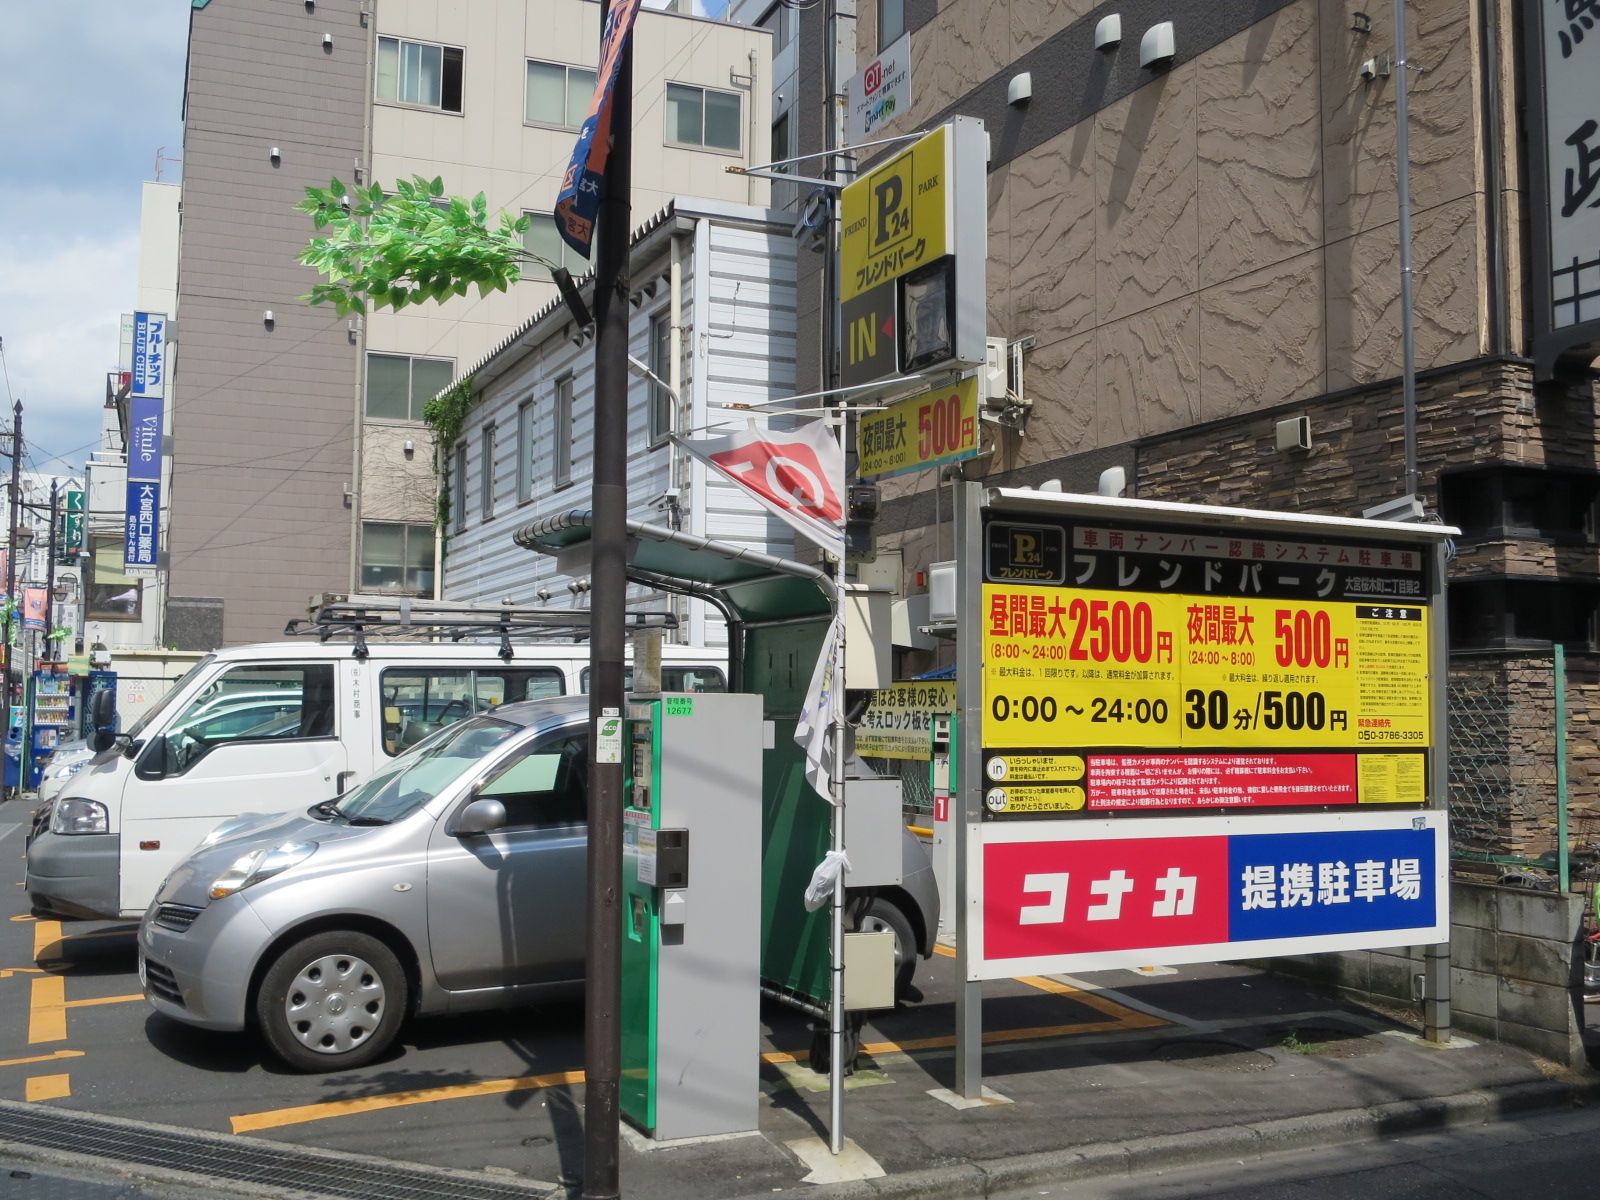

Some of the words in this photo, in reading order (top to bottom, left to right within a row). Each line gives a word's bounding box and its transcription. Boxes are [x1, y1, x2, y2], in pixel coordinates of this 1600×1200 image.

[918, 175, 938, 196] PARK
[856, 238, 926, 290] フレンドパーク
[137, 322, 147, 353] BLUE
[147, 320, 163, 385] ブルーチップ
[850, 312, 876, 365] IN
[135, 355, 146, 385] CHIP
[141, 416, 158, 462] Vitule
[863, 413, 907, 458] 夜間最大
[918, 394, 974, 460] 500円
[70, 493, 83, 545] くすり
[128, 515, 137, 562] 処方せん受付
[138, 484, 154, 562] 大宮西口薬局
[1083, 529, 1413, 568] 車両ナンバー認識システム駐車場
[1000, 567, 1053, 580] フレンドパーク
[1074, 554, 1336, 597] フレンドパーク
[1345, 576, 1420, 594] 大宮桜木町二丁目第2
[989, 594, 1066, 639] 昼間最大
[1068, 598, 1172, 664] 2500円
[1371, 608, 1408, 619] ご注意
[1187, 603, 1254, 646] 夜間最大
[1275, 609, 1349, 669] 500円
[667, 707, 691, 715] 12677
[1357, 718, 1391, 728] 緊急連絡先
[1358, 730, 1424, 741] 050-3786-3305
[992, 764, 1003, 774] in
[938, 799, 944, 819] 1
[988, 793, 1006, 805] out
[1019, 867, 1198, 925] コナカ
[1241, 858, 1422, 911] 提携駐車場
